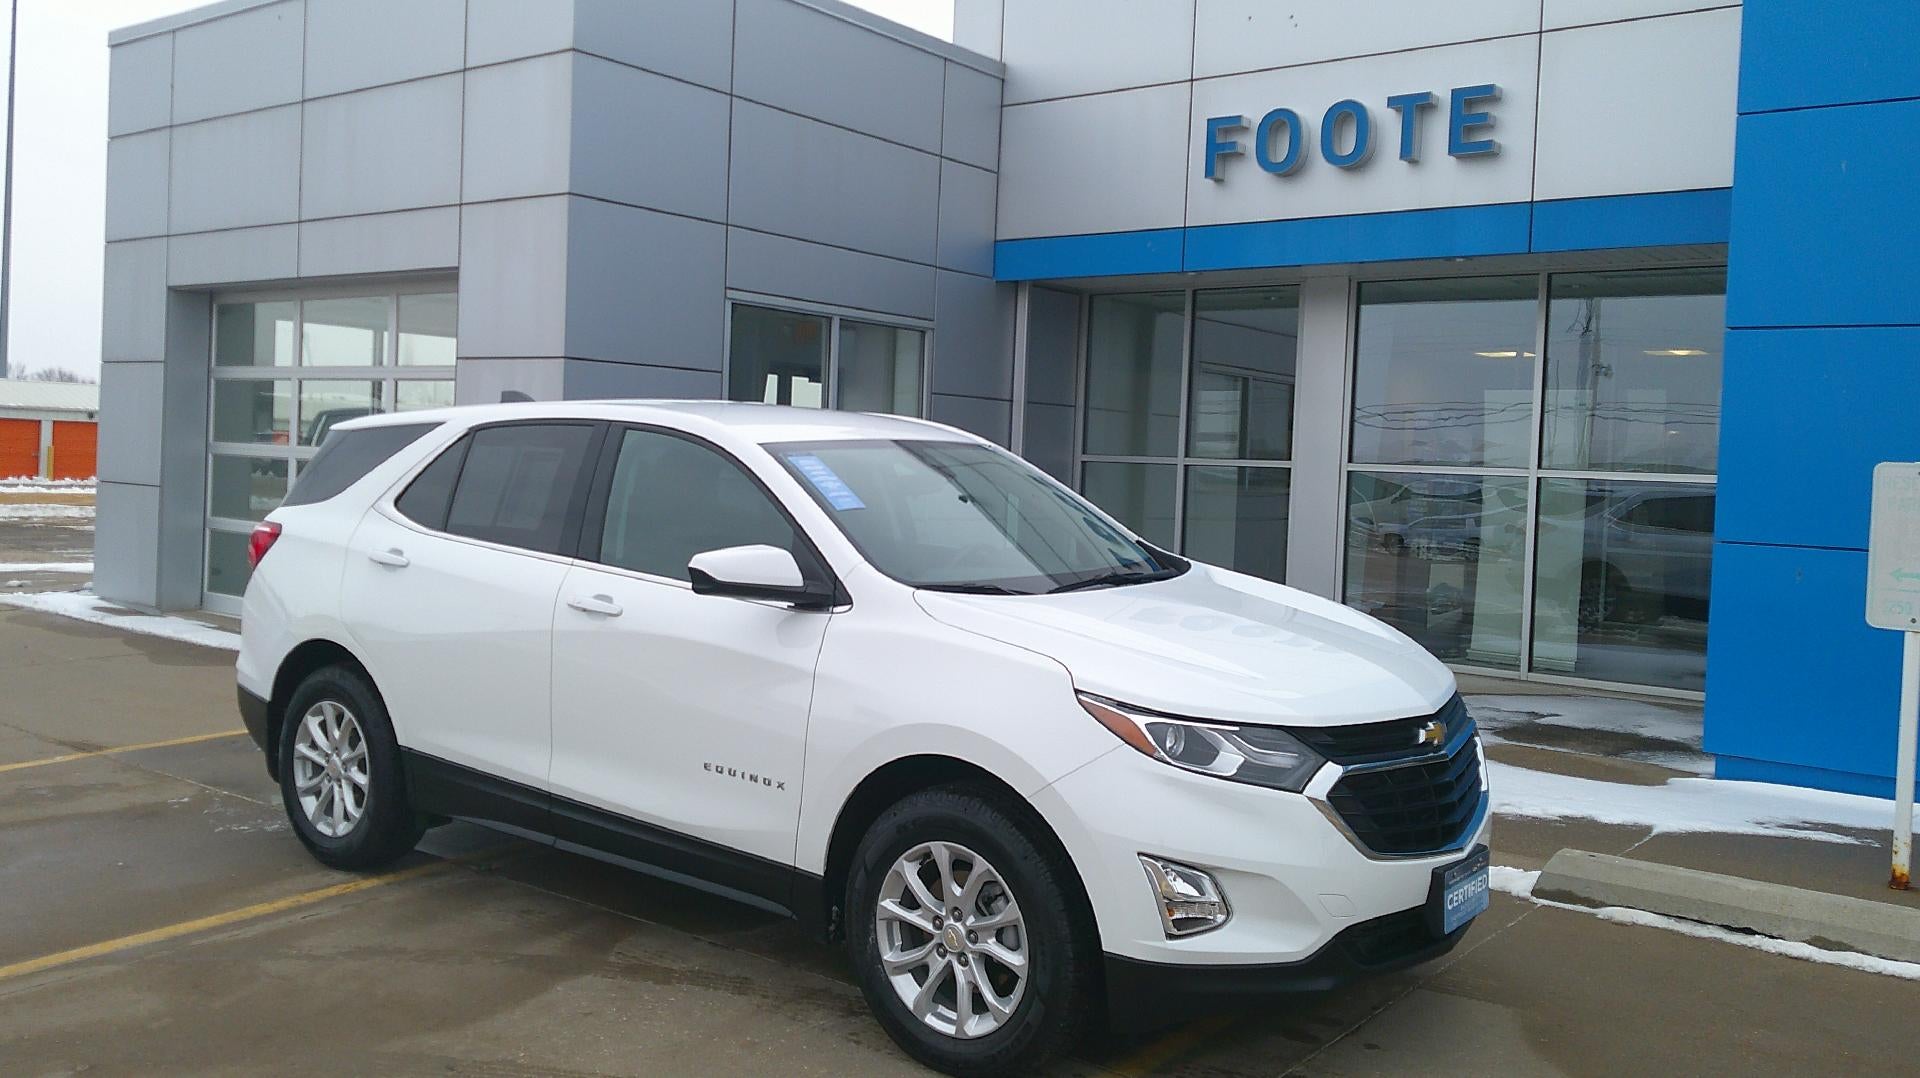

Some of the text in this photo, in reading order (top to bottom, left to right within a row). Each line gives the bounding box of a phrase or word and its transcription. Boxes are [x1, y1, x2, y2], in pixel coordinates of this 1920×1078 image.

[1204, 83, 1501, 181] FOOTE
[703, 762, 785, 791] EQUINOX
[1447, 874, 1488, 910] CERTIFIED
